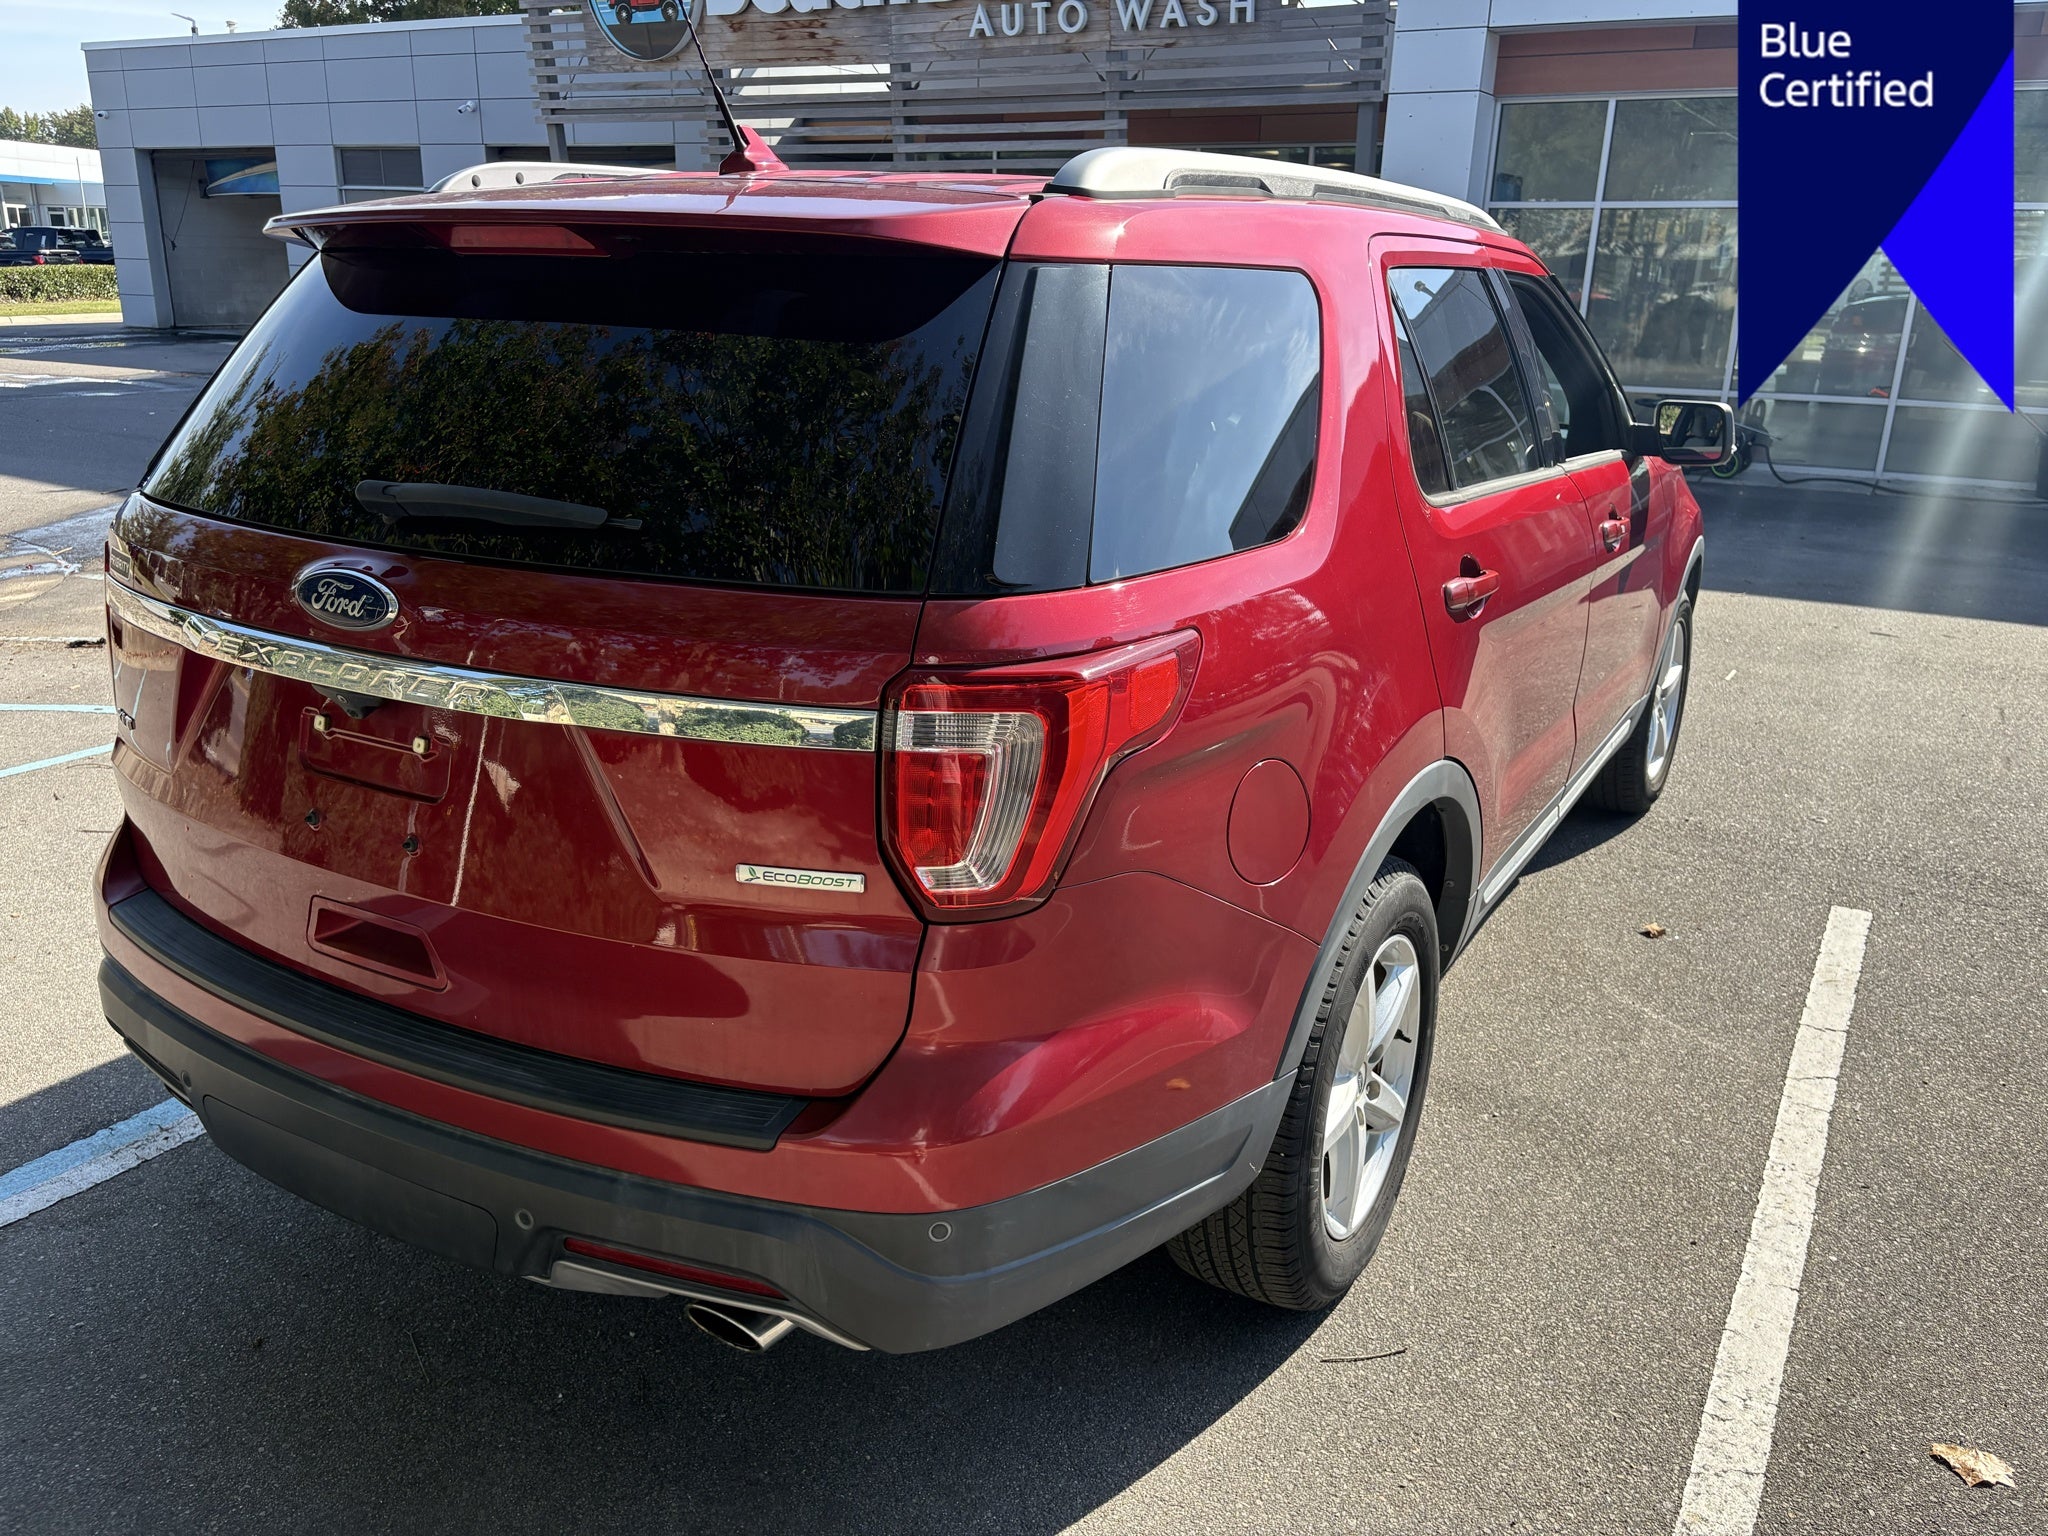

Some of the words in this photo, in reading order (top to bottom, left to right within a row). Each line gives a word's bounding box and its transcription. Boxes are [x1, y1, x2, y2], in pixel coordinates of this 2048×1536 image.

[968, 0, 1088, 38] AUTO
[1115, 0, 1255, 32] WASH
[311, 578, 367, 618] Ford
[213, 633, 491, 710] EXPLORER
[762, 871, 857, 888] ECOBOOST
